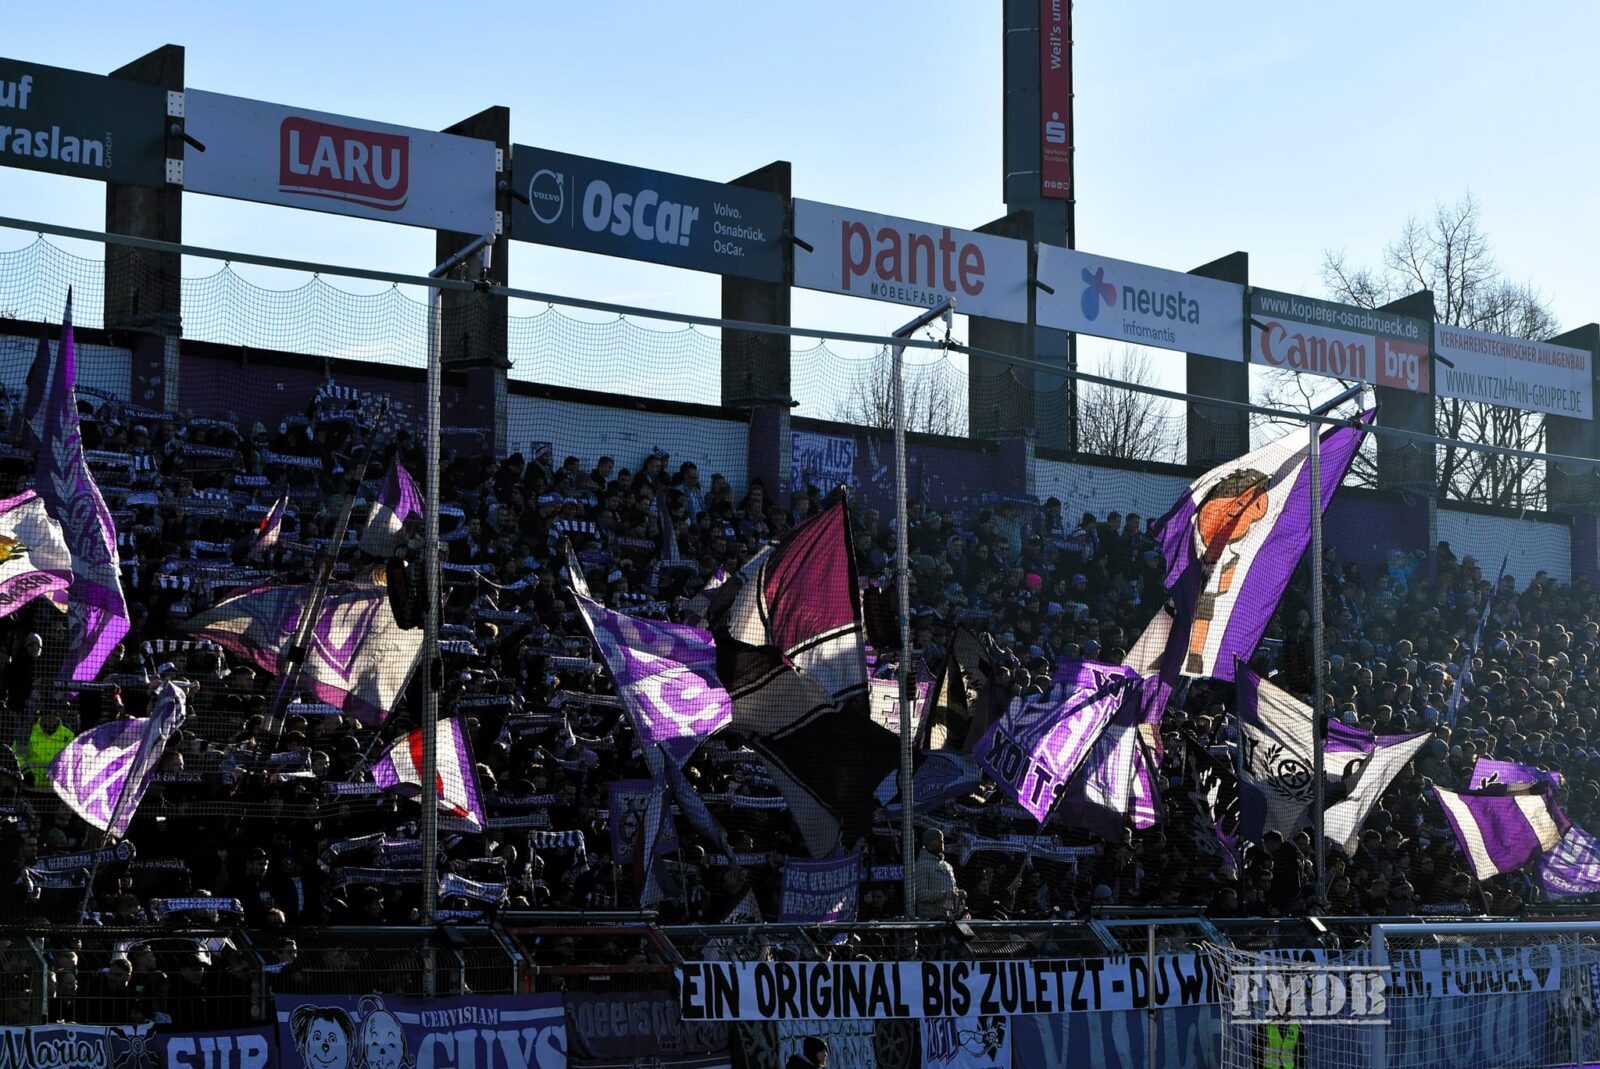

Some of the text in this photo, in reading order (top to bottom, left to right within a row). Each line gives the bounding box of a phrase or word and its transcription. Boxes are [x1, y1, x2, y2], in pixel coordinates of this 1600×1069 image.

[0, 74, 33, 110] uf
[0, 125, 104, 167] raslan
[289, 129, 401, 190] LARU
[533, 191, 560, 203] VOLVO
[713, 202, 742, 220] Volvo.
[713, 221, 767, 243] Osnabrück.
[713, 240, 745, 258] OsCar.
[842, 220, 986, 297] pante
[1122, 286, 1200, 325] neusta
[1260, 296, 1419, 339] www.kopierer-osnabrueck.de
[1122, 318, 1176, 344] infomantis
[1440, 330, 1585, 371] VERFAHRENSTECHNISCHER ANLAGENBAU
[1260, 321, 1420, 391] Canon brg
[1445, 369, 1582, 413] WWW.KITZMANN-GRUPPE.DE
[683, 963, 740, 1018] EIN
[754, 962, 910, 1018] ORIGINAL
[922, 961, 971, 1016] BIS
[979, 959, 1105, 1015] ZULETZT
[421, 1005, 499, 1028] CERVISIAM
